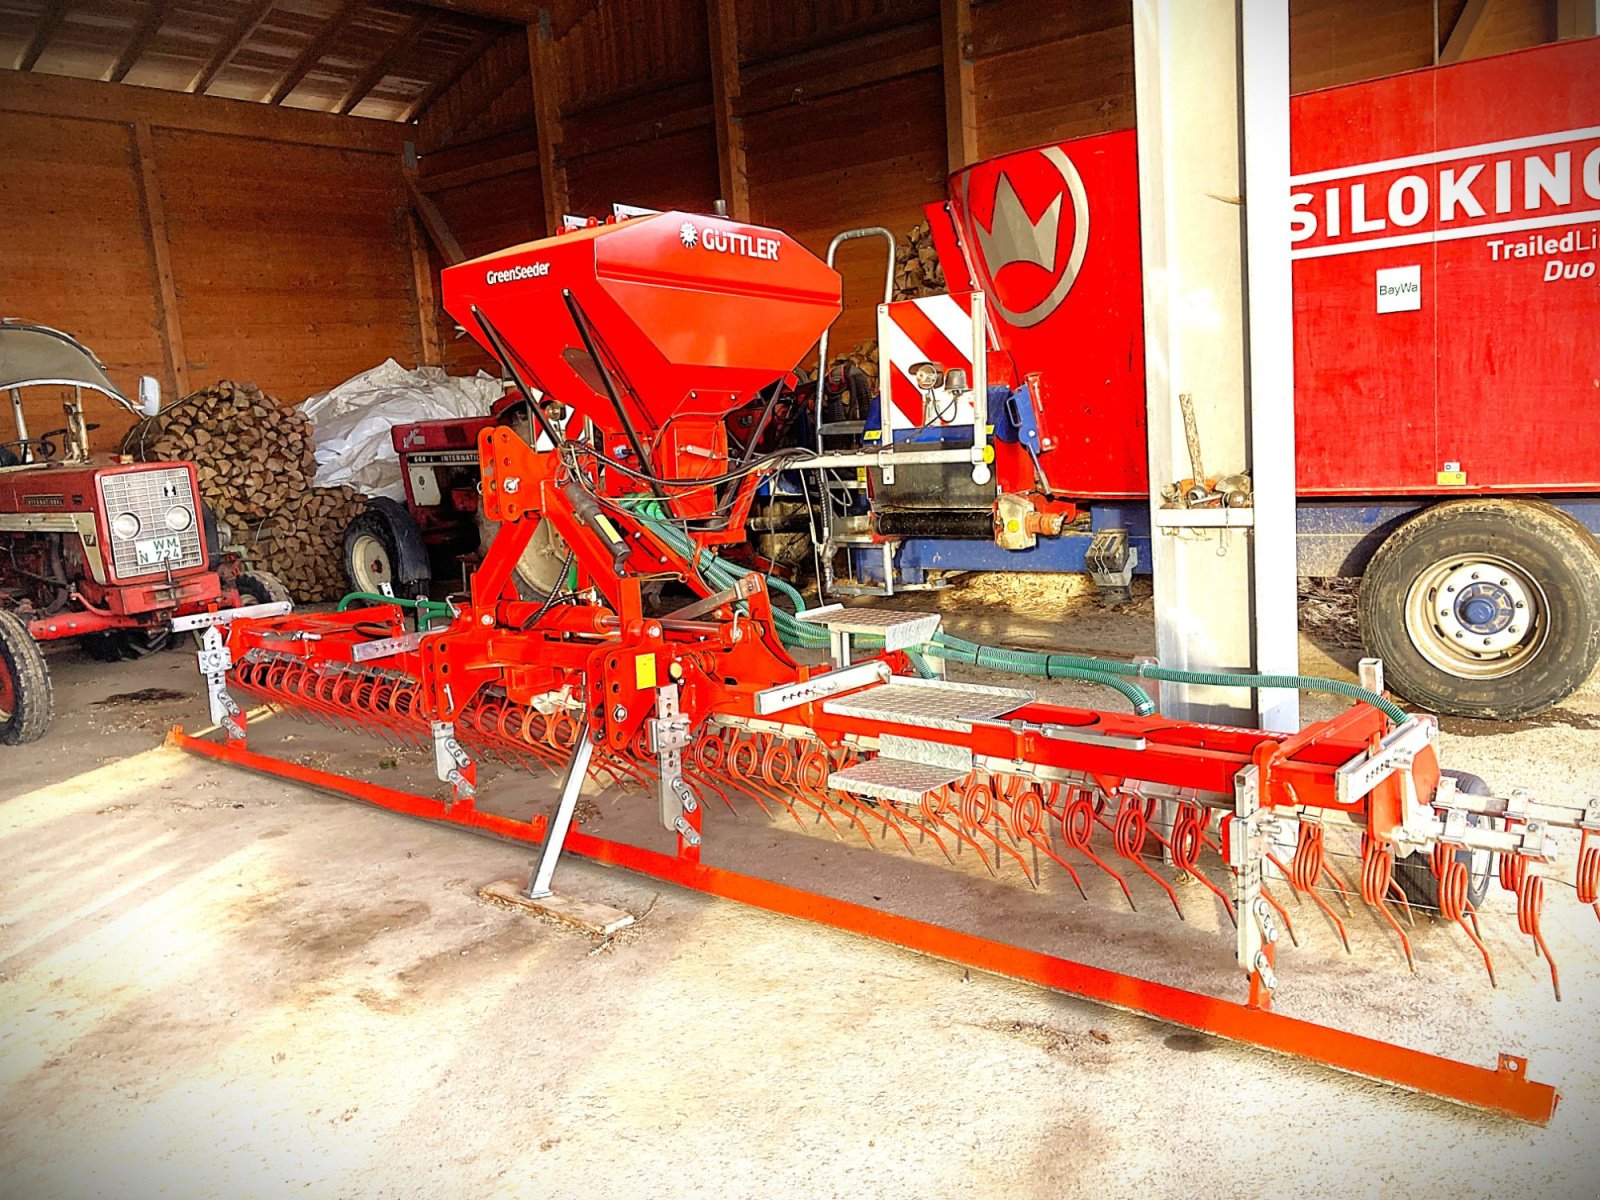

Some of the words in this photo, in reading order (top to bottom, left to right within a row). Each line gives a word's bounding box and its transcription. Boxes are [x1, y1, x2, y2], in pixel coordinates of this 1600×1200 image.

[1487, 229, 1600, 261] TrailedLi
[486, 261, 551, 285] GreenSeeder
[1543, 260, 1596, 281] Duo
[1379, 282, 1418, 297] BayWa
[153, 537, 177, 551] WM
[155, 548, 180, 561] 724
